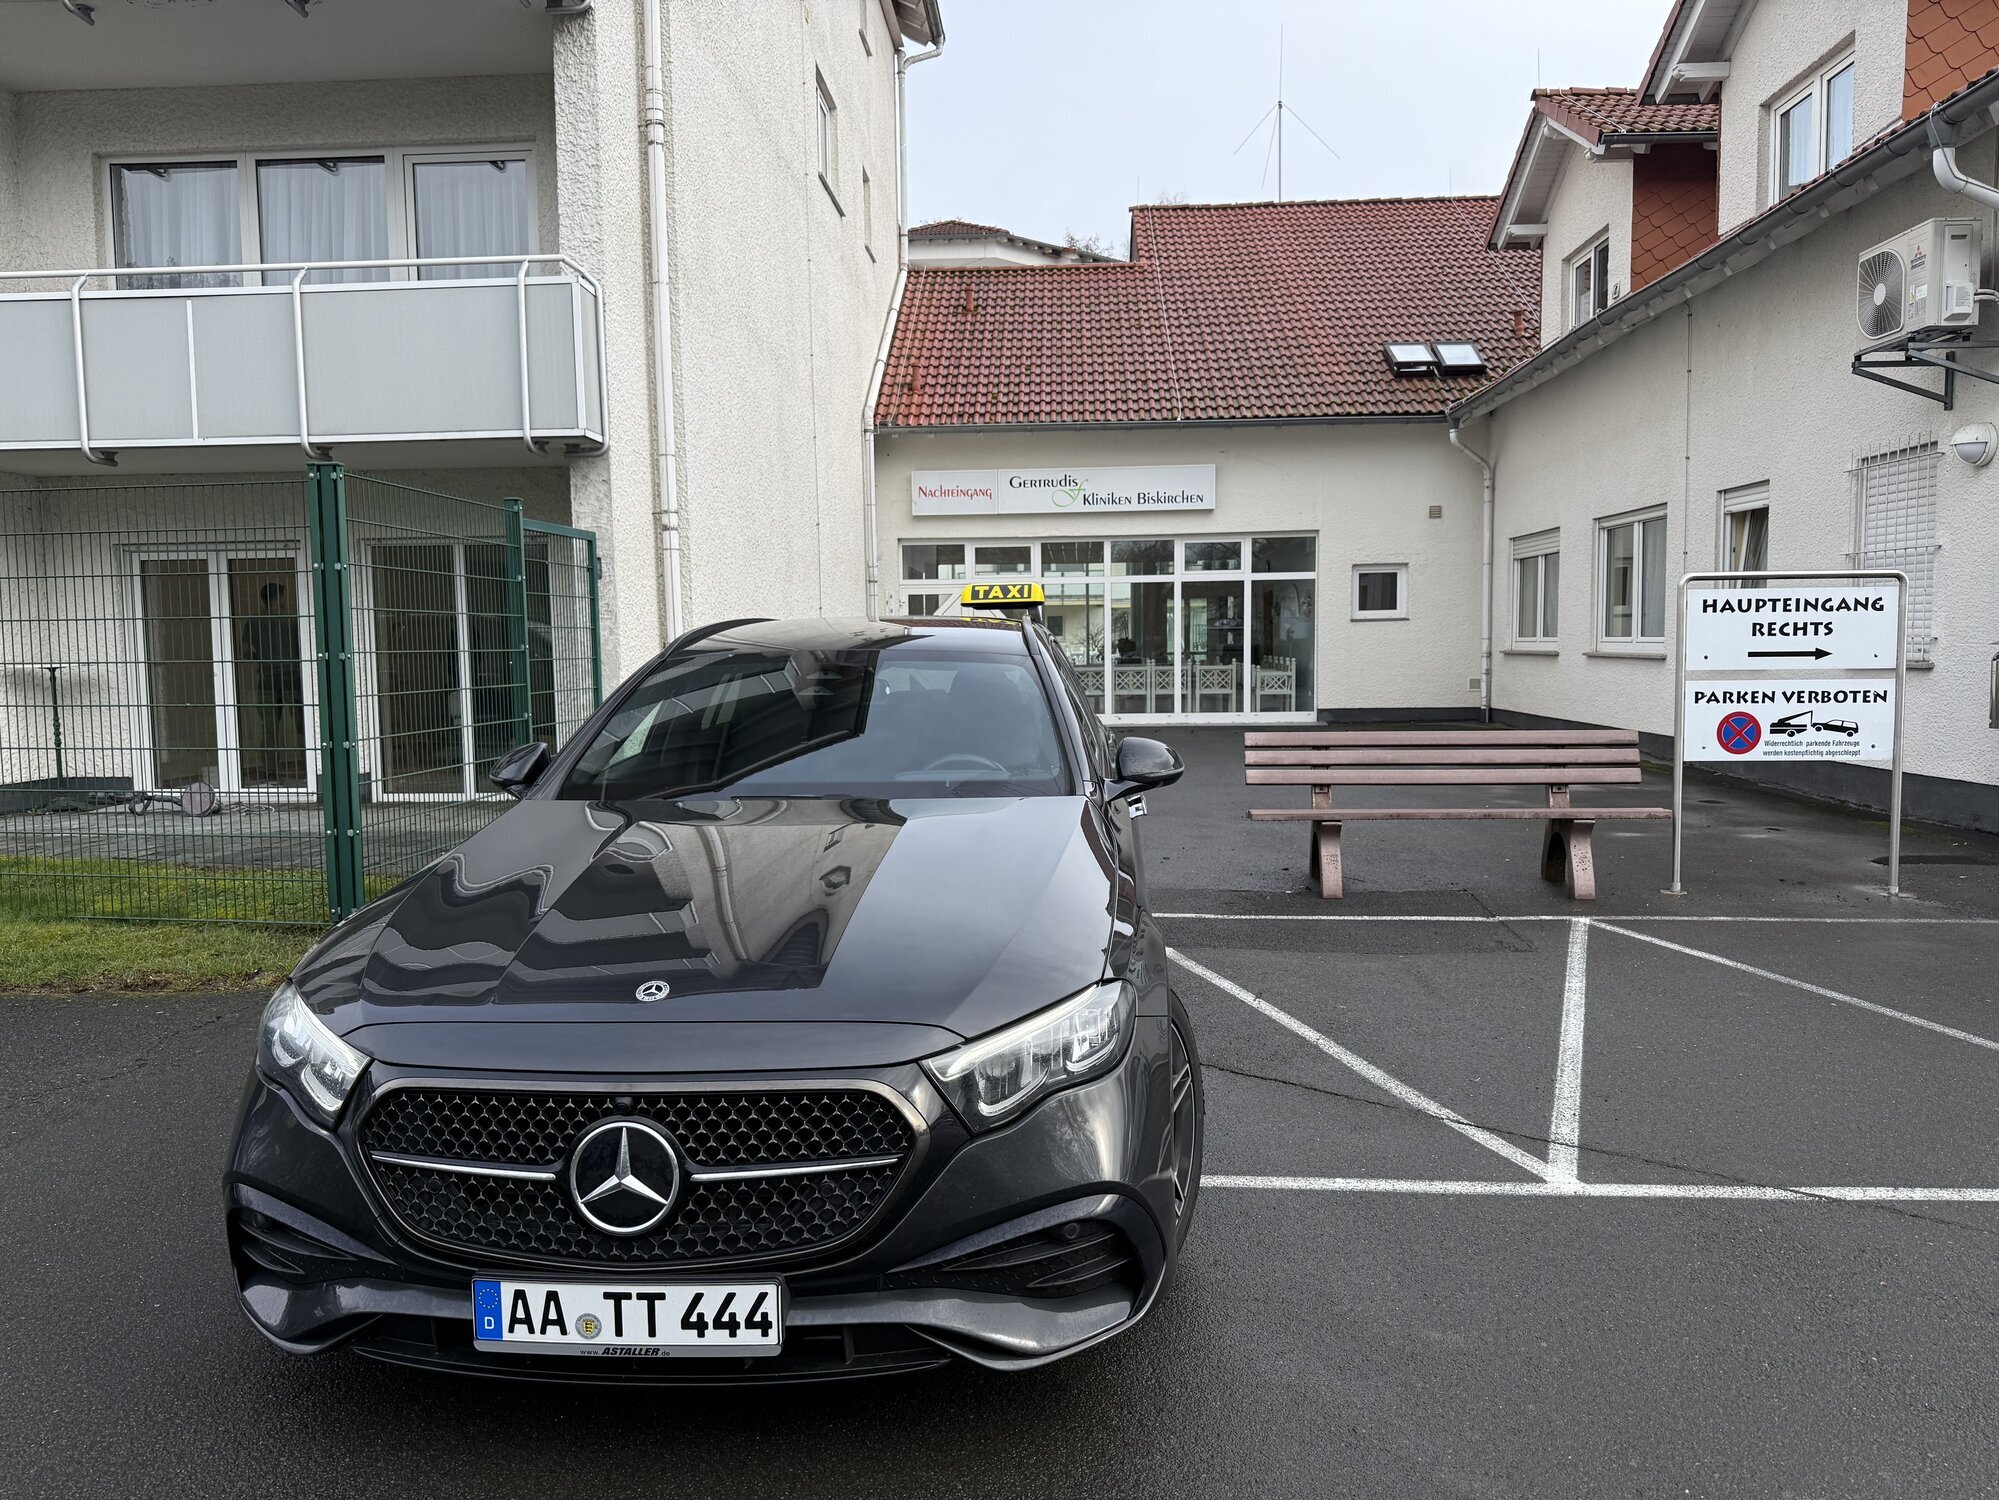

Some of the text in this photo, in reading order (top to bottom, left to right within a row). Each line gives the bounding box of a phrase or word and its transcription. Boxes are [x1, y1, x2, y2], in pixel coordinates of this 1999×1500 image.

[975, 585, 1029, 599] TAXI
[1702, 596, 1885, 614] HAUPTEINGANG
[1751, 621, 1834, 637] RECHTS
[1694, 689, 1888, 705] PARKEN VERBOTEN
[1764, 739, 1860, 748] Widerrechtlich parkende Fahrzeuge
[1783, 749, 1824, 757] kostenpflichtig
[1825, 749, 1861, 757] abgeschleppt
[507, 1288, 569, 1336] AA
[602, 1291, 667, 1338] TT
[680, 1291, 774, 1339] 444
[483, 1316, 496, 1331] D
